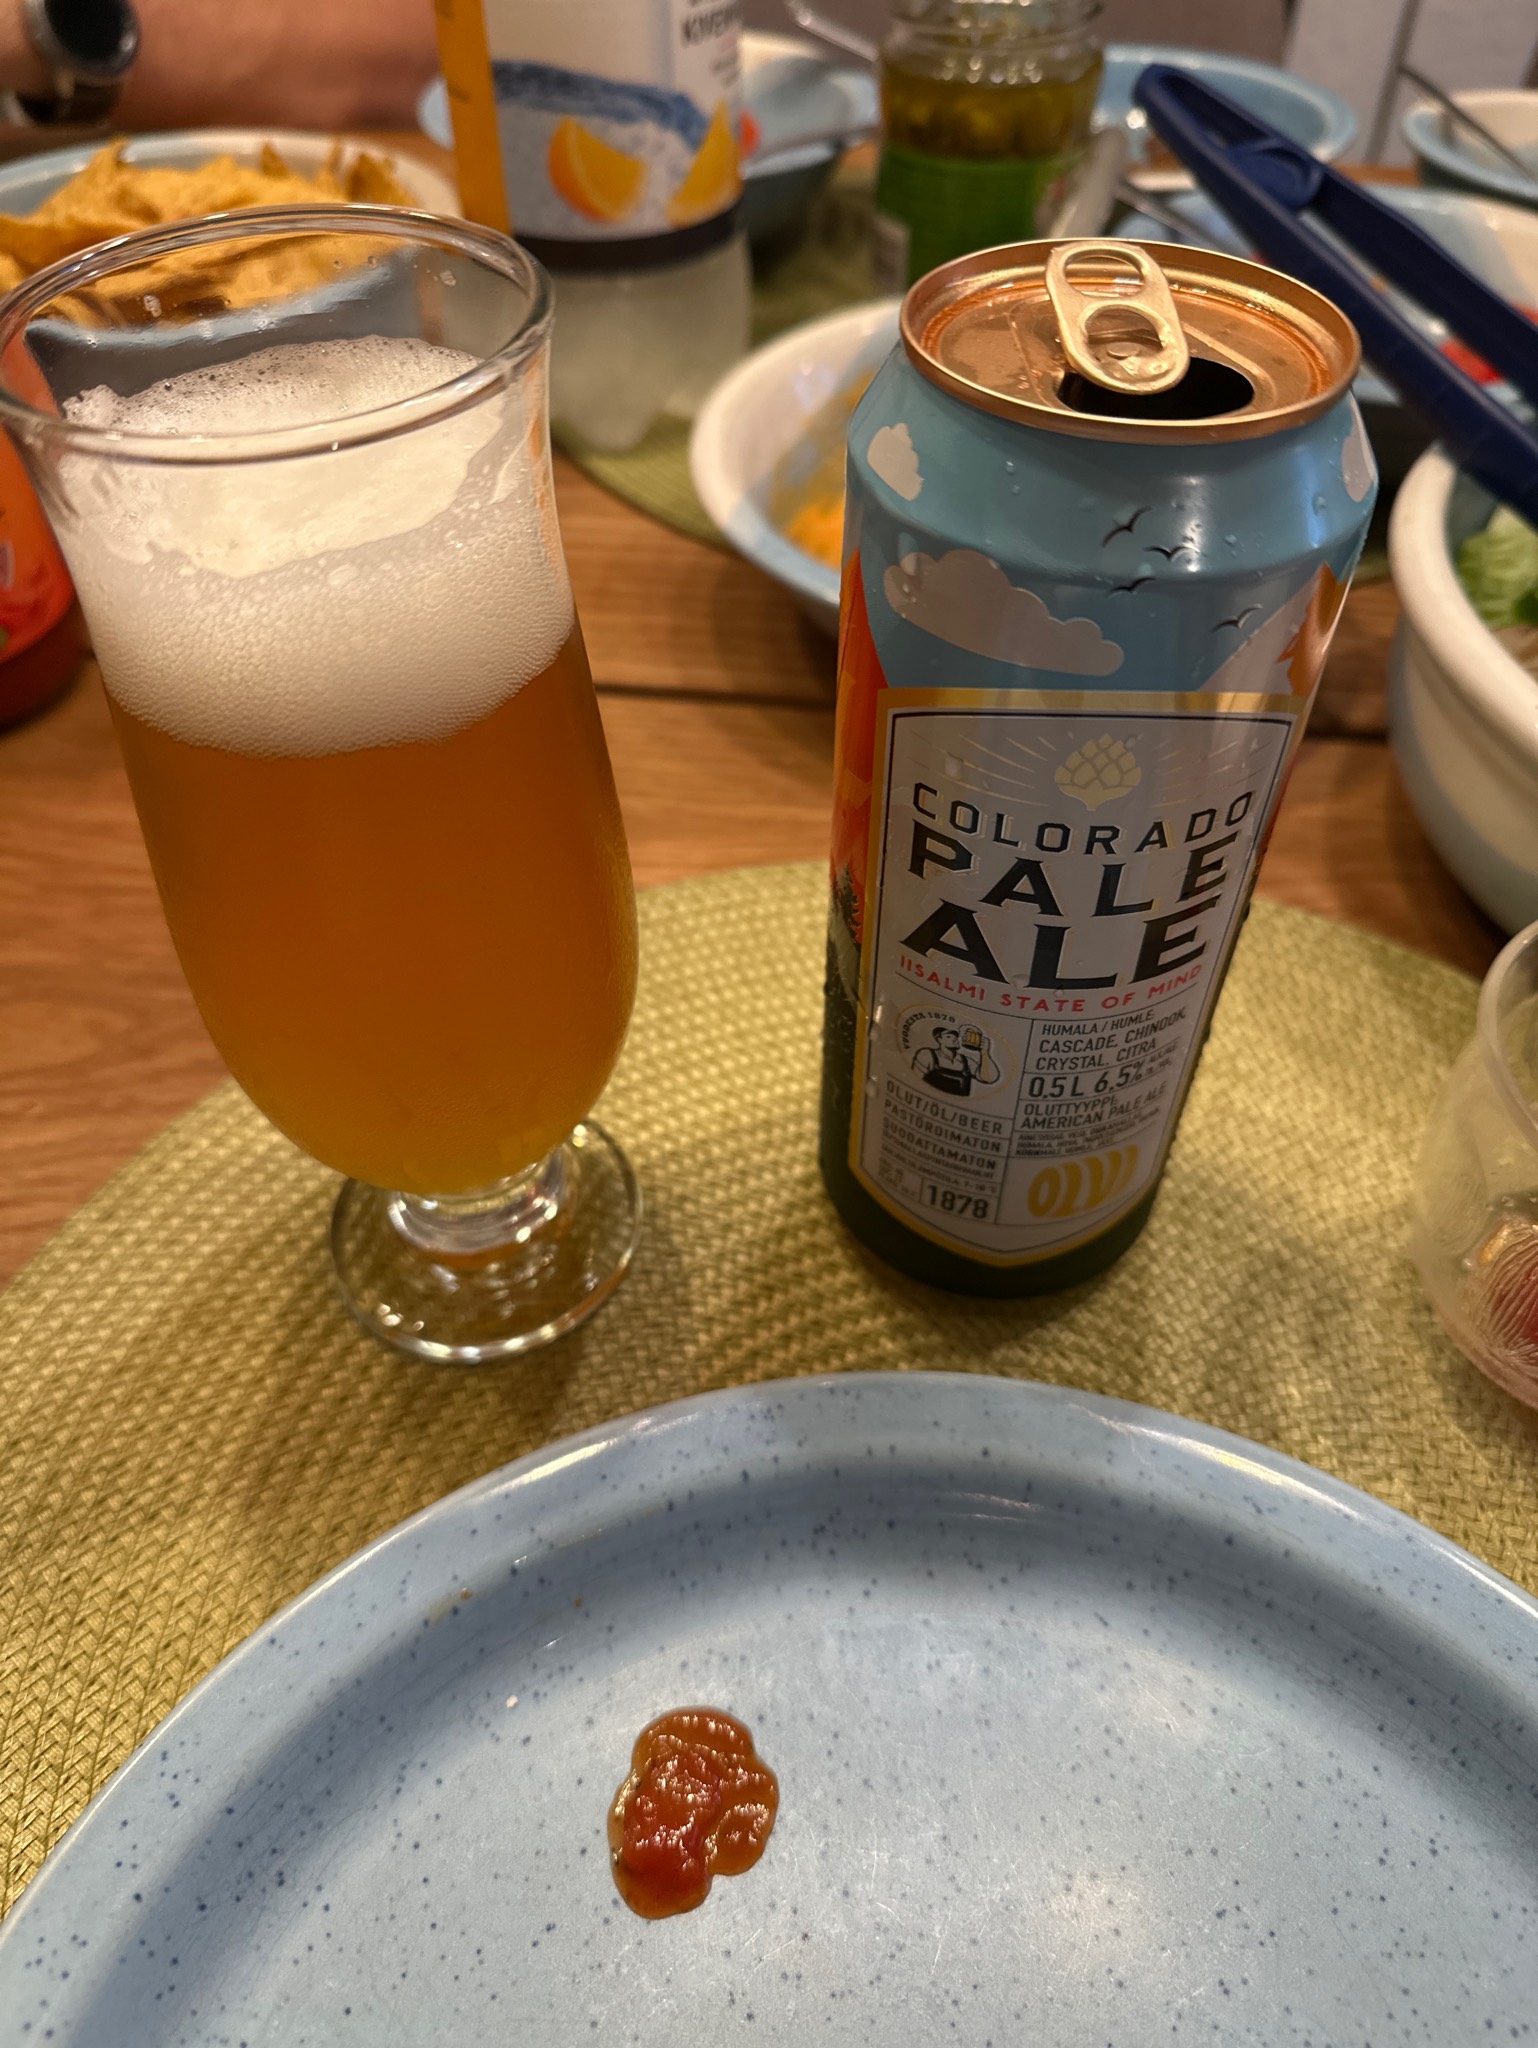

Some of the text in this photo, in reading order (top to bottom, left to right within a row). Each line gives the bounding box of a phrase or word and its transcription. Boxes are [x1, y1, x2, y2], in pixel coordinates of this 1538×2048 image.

[912, 782, 1254, 855] COLORADO
[907, 819, 1238, 917] PALE
[900, 894, 1222, 990] ALE
[901, 955, 1203, 1012] IISALMI STATE OF MIND
[901, 1012, 956, 1050] VUODESTA 1878
[1041, 1023, 1098, 1036] HUMALA
[1110, 1009, 1155, 1031] HUMLE
[1116, 1038, 1157, 1062] CITRA
[1020, 1110, 1104, 1129] AMERICAN
[1107, 1095, 1142, 1119] PALE
[1144, 1080, 1168, 1104] ALE
[928, 1184, 989, 1219] 1878
